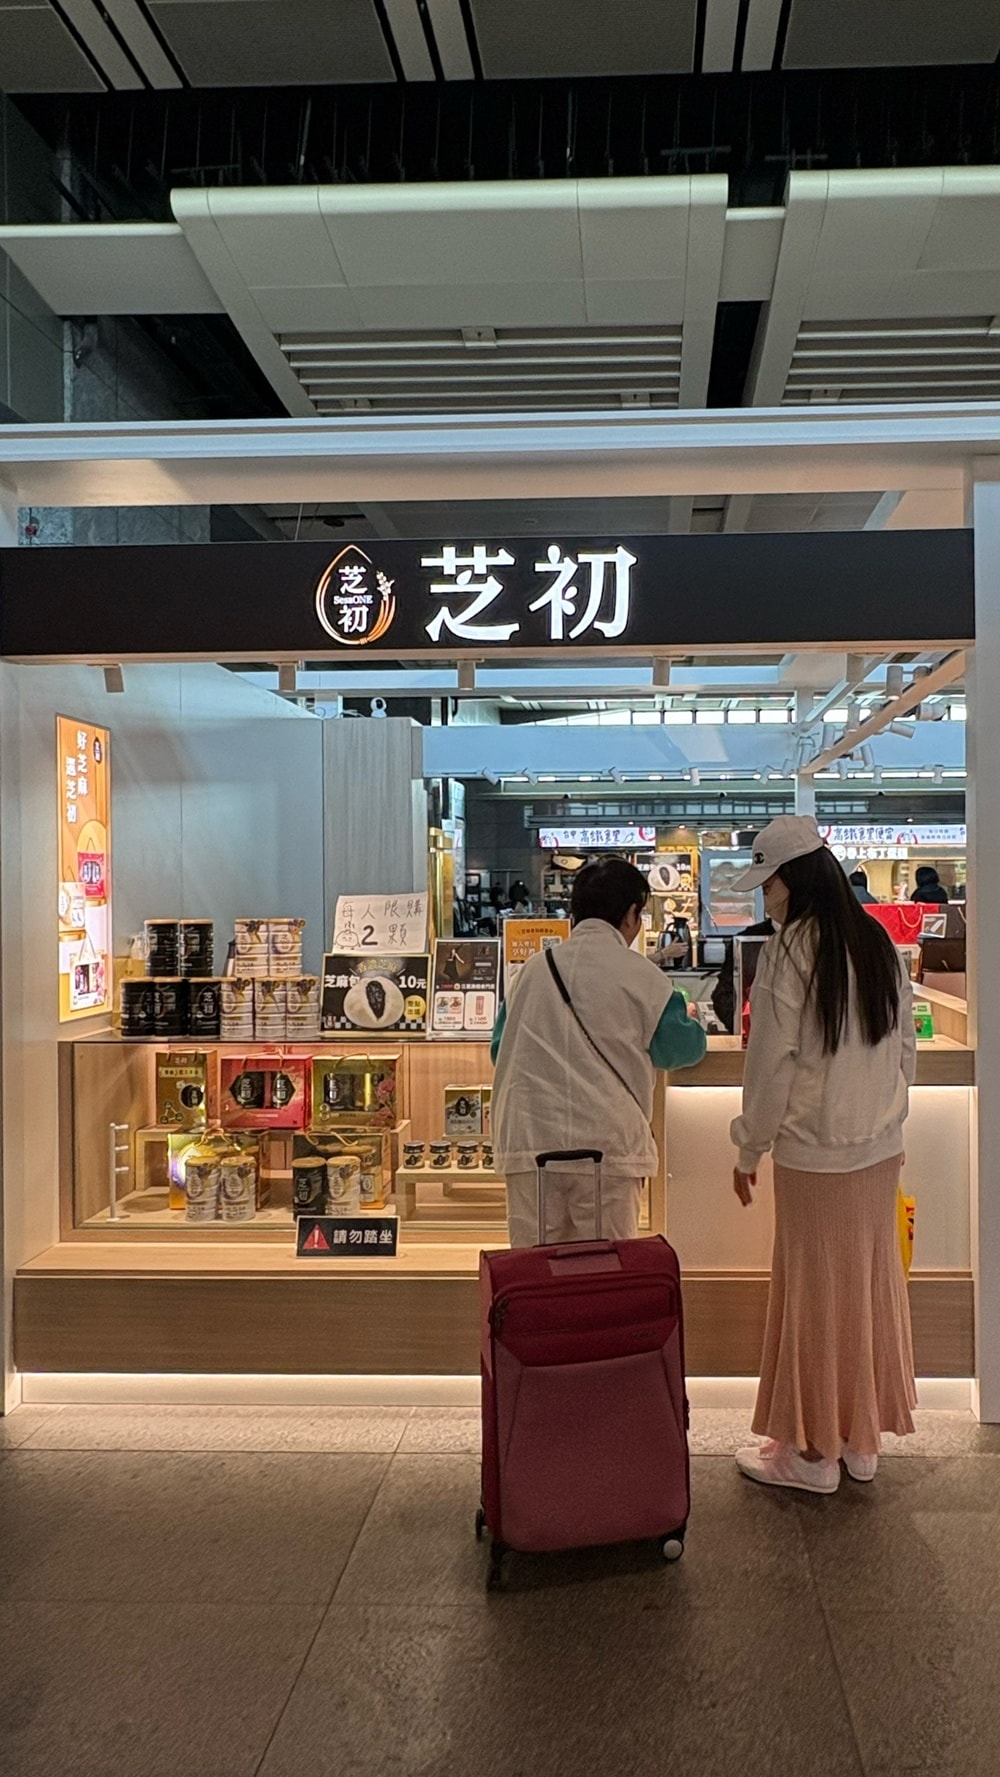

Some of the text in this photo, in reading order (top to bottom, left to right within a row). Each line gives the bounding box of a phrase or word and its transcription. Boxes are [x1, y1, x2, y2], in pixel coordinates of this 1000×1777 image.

[421, 545, 637, 642] 芝初
[77, 730, 88, 796] 好芝麻
[66, 756, 77, 823] 選芝初
[342, 899, 424, 921] 每人限購
[399, 975, 427, 989] 10元
[333, 1228, 393, 1245] 請勿踏坐
